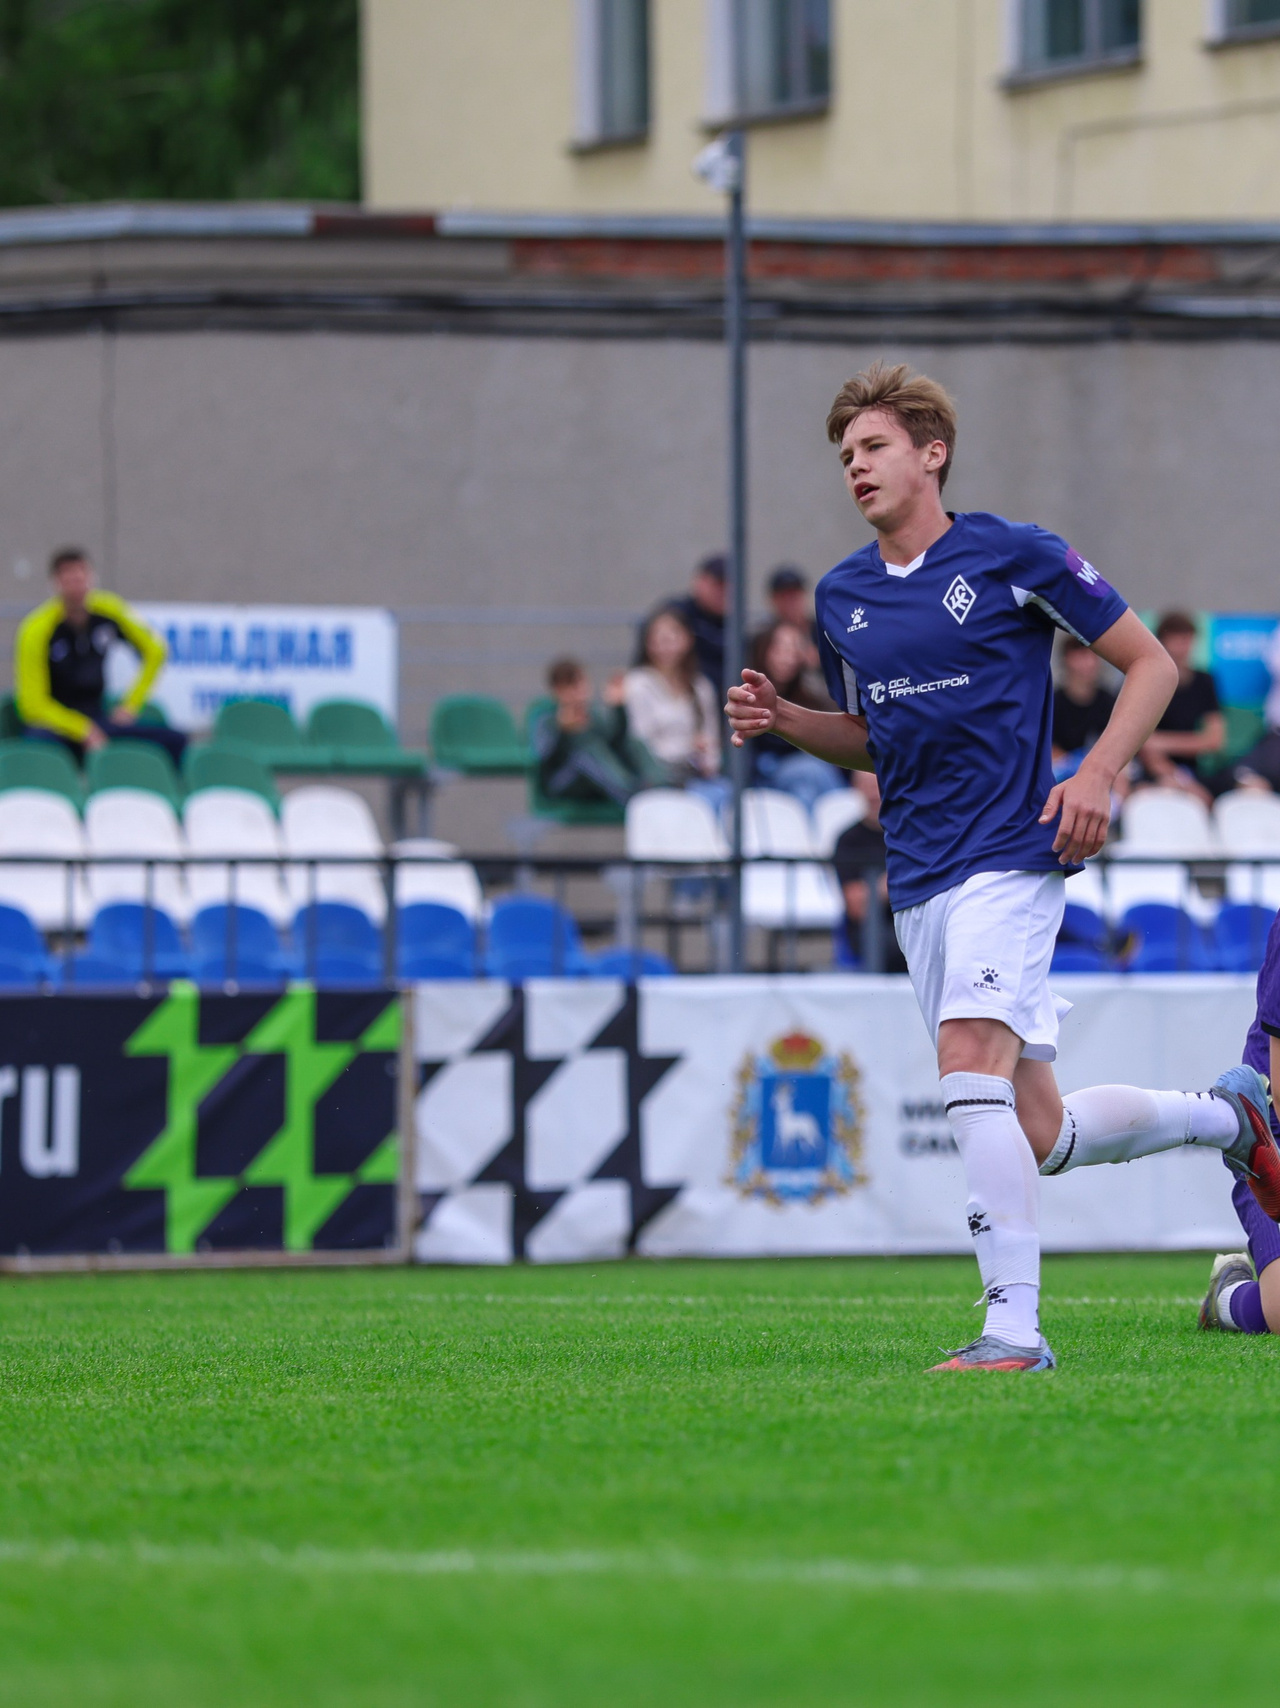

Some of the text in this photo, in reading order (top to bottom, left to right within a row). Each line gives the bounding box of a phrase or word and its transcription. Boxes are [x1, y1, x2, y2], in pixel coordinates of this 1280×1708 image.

[846, 621, 869, 634] KELME
[164, 618, 355, 674] АПАДНАЯ
[888, 674, 970, 699] ТРАНССТРОЙ
[973, 982, 1002, 993] KELME
